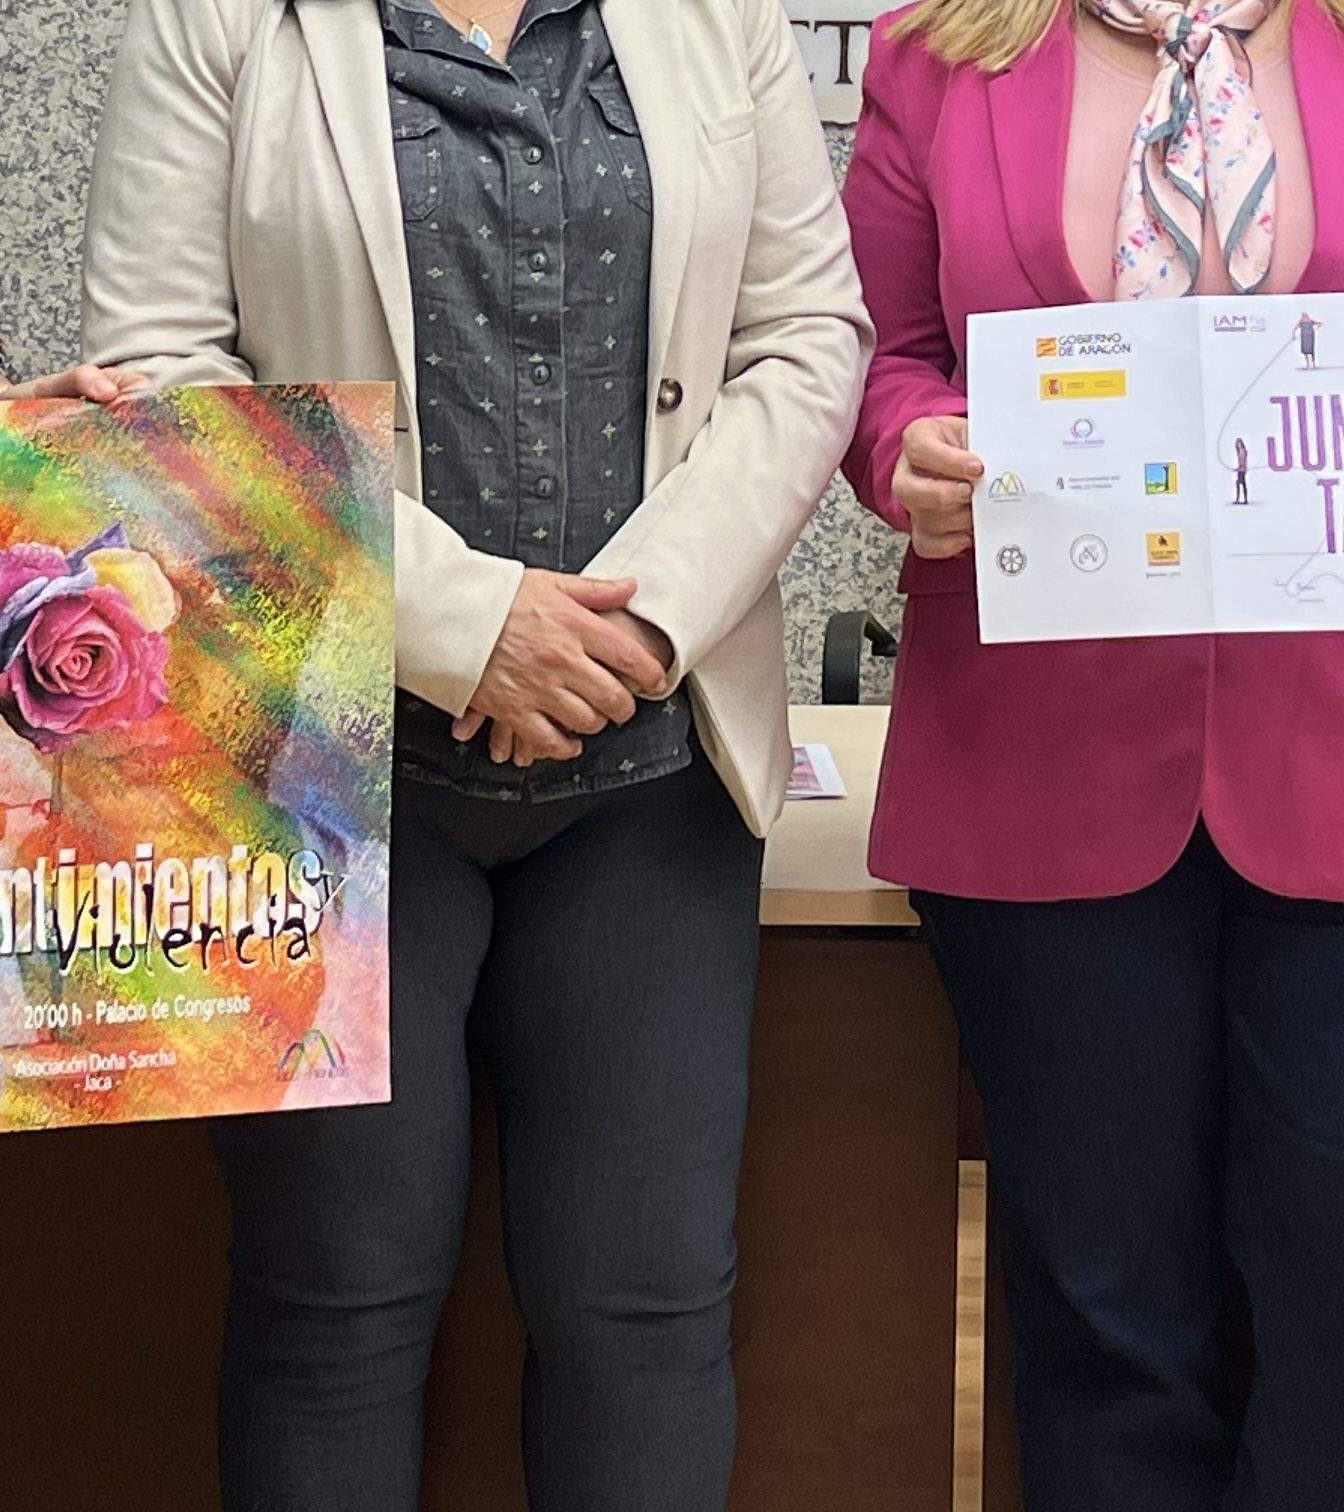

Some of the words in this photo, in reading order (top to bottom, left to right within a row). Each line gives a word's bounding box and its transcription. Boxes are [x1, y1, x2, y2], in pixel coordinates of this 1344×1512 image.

[57, 889, 313, 975] Violencia
[95, 998, 148, 1025] Palacio
[152, 996, 170, 1020] de
[174, 994, 252, 1022] Congresos
